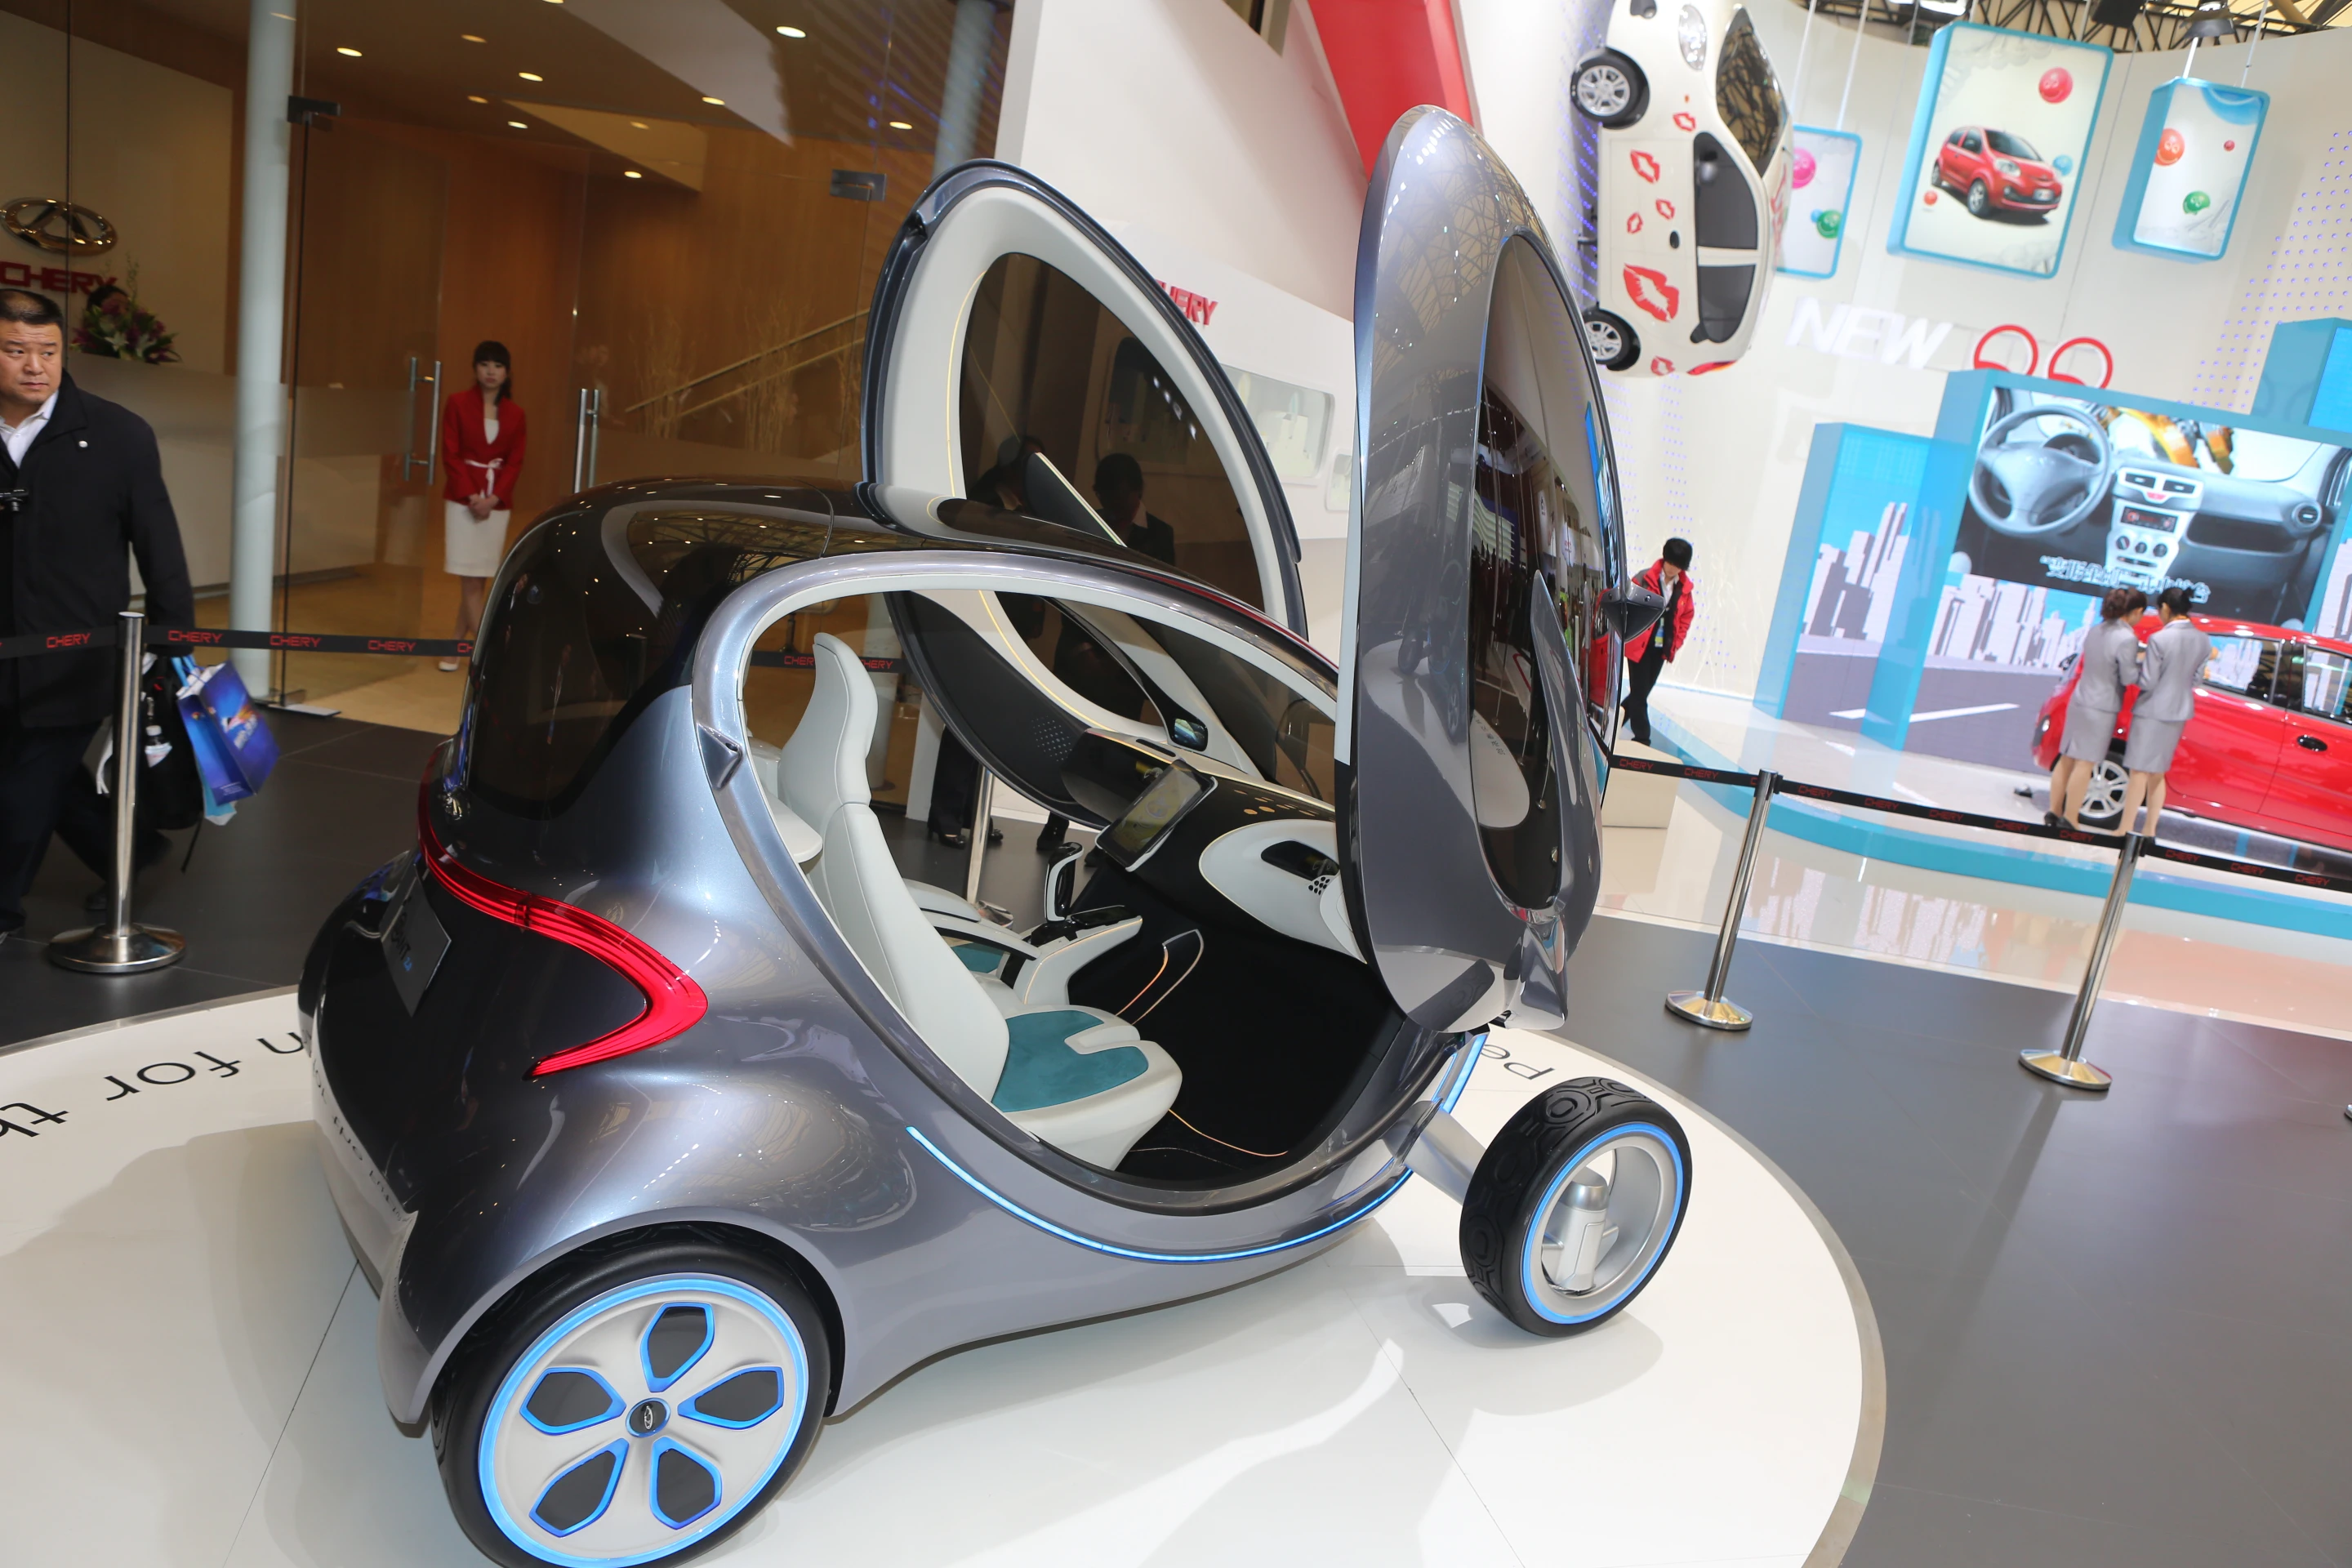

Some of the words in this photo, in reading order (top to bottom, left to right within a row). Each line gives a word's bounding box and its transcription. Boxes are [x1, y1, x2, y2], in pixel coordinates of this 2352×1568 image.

[1156, 279, 1218, 325] ERY
[1785, 296, 1953, 370] NEW
[47, 633, 91, 648] CHERY
[168, 630, 224, 644] CHERY
[270, 635, 322, 648] CHERY
[368, 639, 416, 653] CHERY
[783, 655, 814, 666] CHER
[1619, 758, 1654, 771] CHERY
[1684, 767, 1719, 780] CHERY
[1798, 785, 1833, 798] CHERY
[1864, 797, 1900, 811] CHERY
[1929, 809, 1964, 822] CHERY
[1994, 820, 2030, 832] CHERY
[2060, 830, 2095, 843] CHERY
[2165, 849, 2200, 862] CHERY
[2230, 862, 2266, 875] CHERY
[2295, 874, 2330, 886] CHERY
[104, 1051, 243, 1102] for
